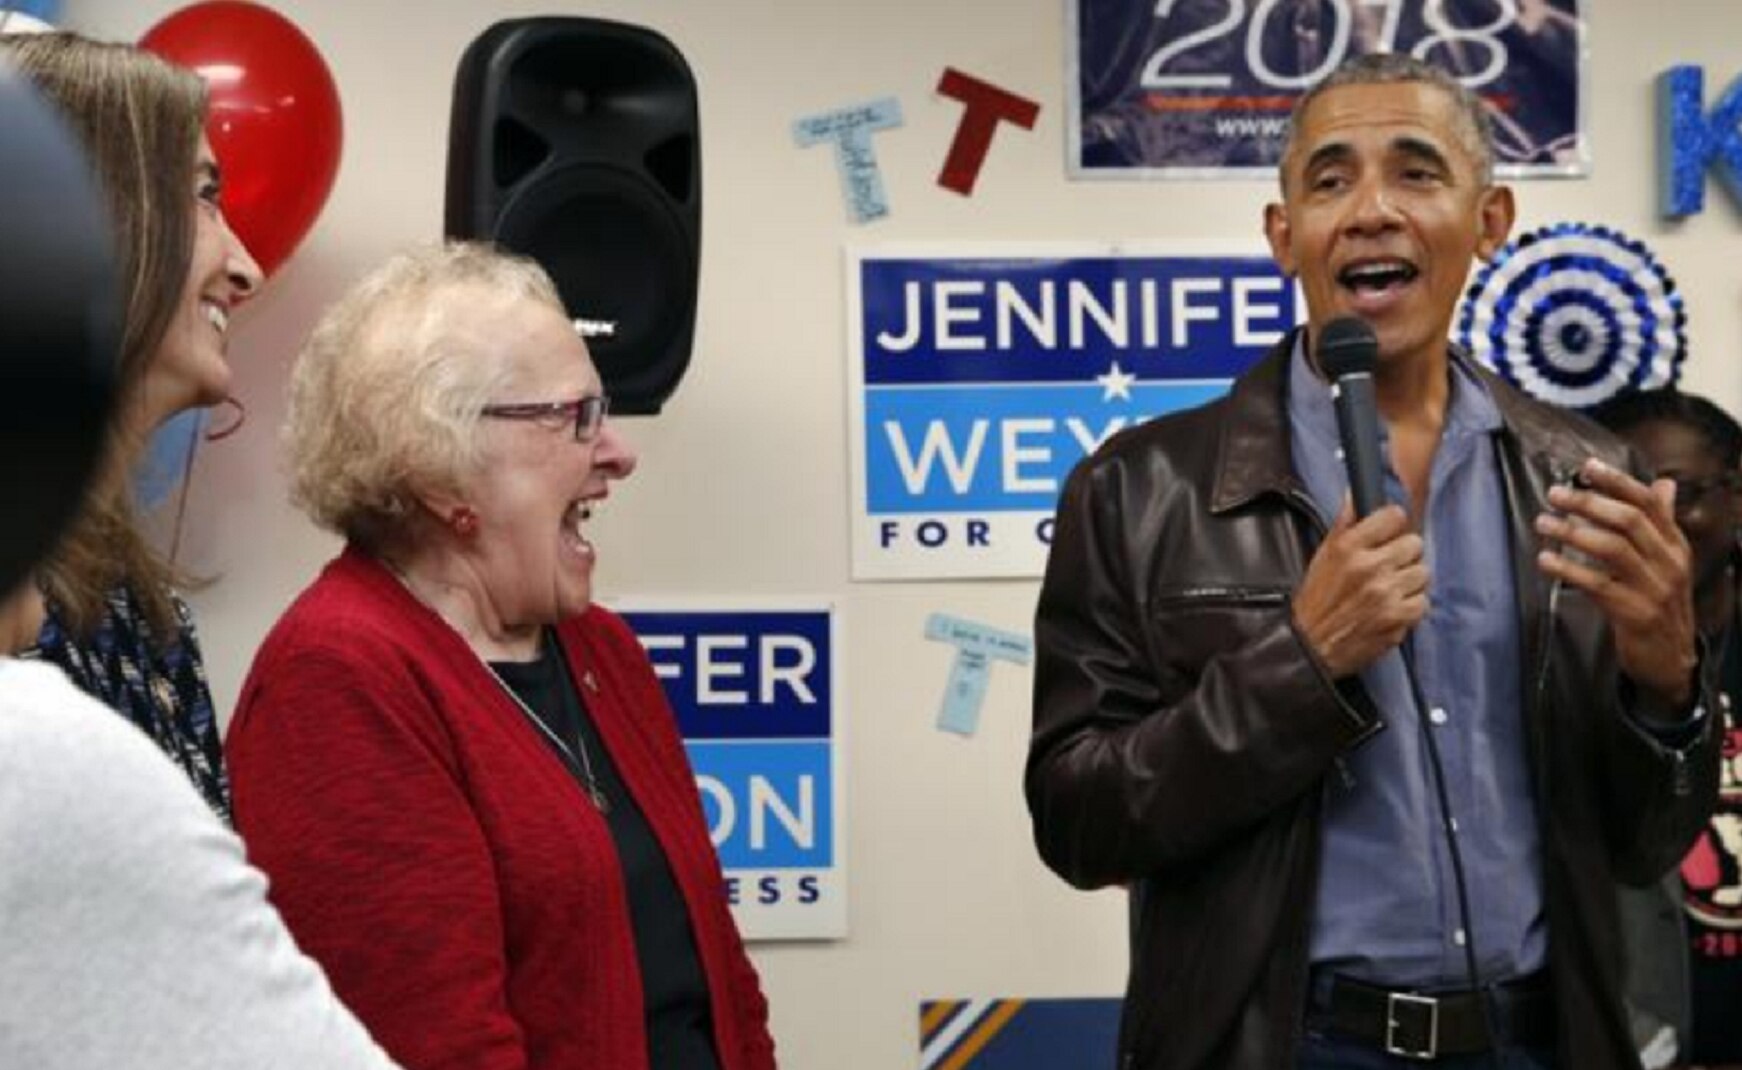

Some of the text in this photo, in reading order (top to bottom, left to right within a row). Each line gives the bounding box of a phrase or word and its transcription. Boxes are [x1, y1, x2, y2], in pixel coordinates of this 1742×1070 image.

[1140, 0, 1516, 88] 2018
[884, 416, 1152, 495] WE
[880, 521, 989, 548] FOR
